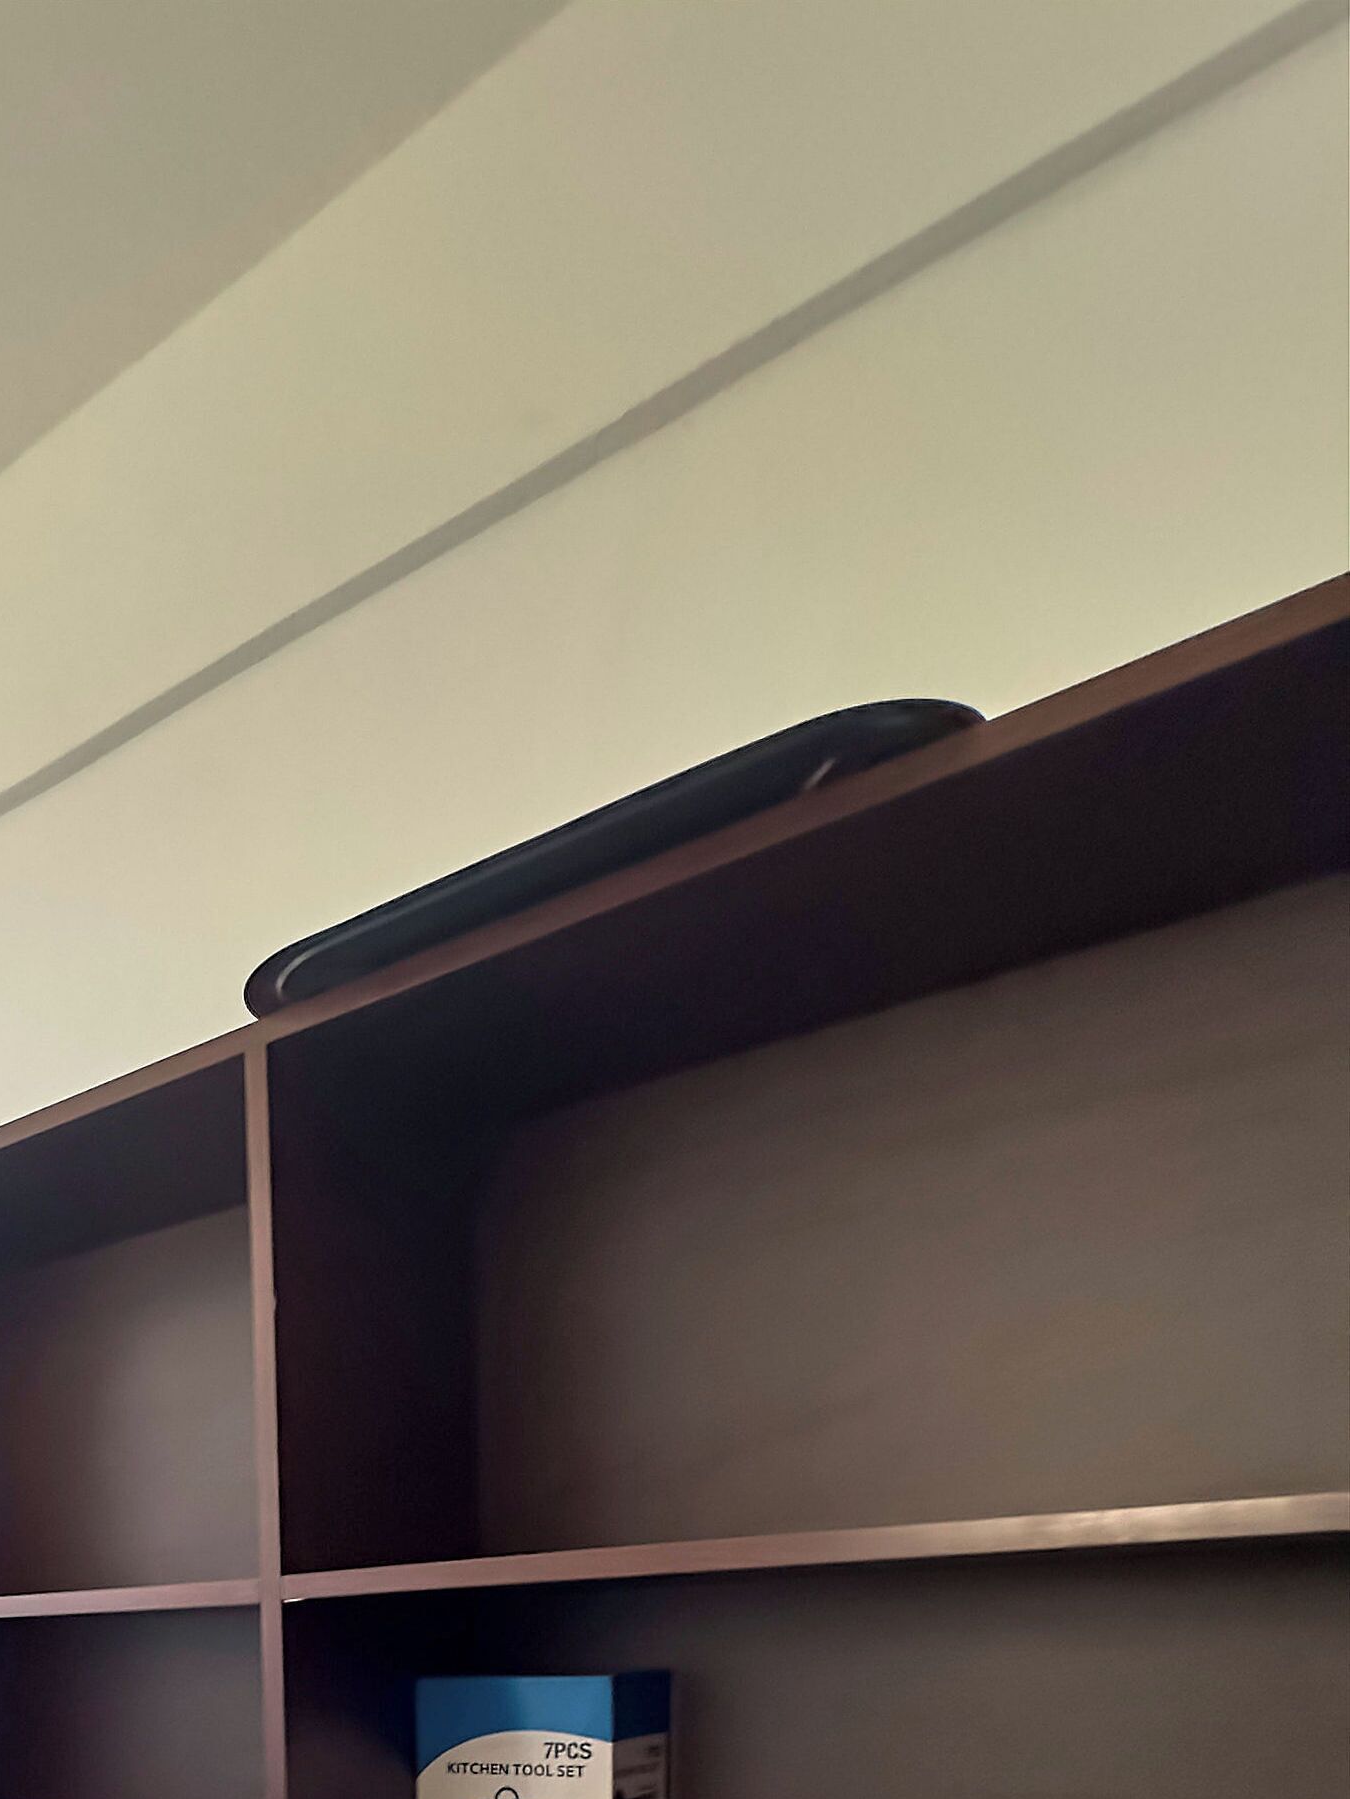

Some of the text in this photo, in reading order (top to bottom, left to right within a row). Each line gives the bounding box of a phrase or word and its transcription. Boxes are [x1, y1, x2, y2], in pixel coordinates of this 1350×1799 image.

[544, 1742, 592, 1759] 7PCS
[447, 1762, 586, 1777] KITCHEN TOOL SET
